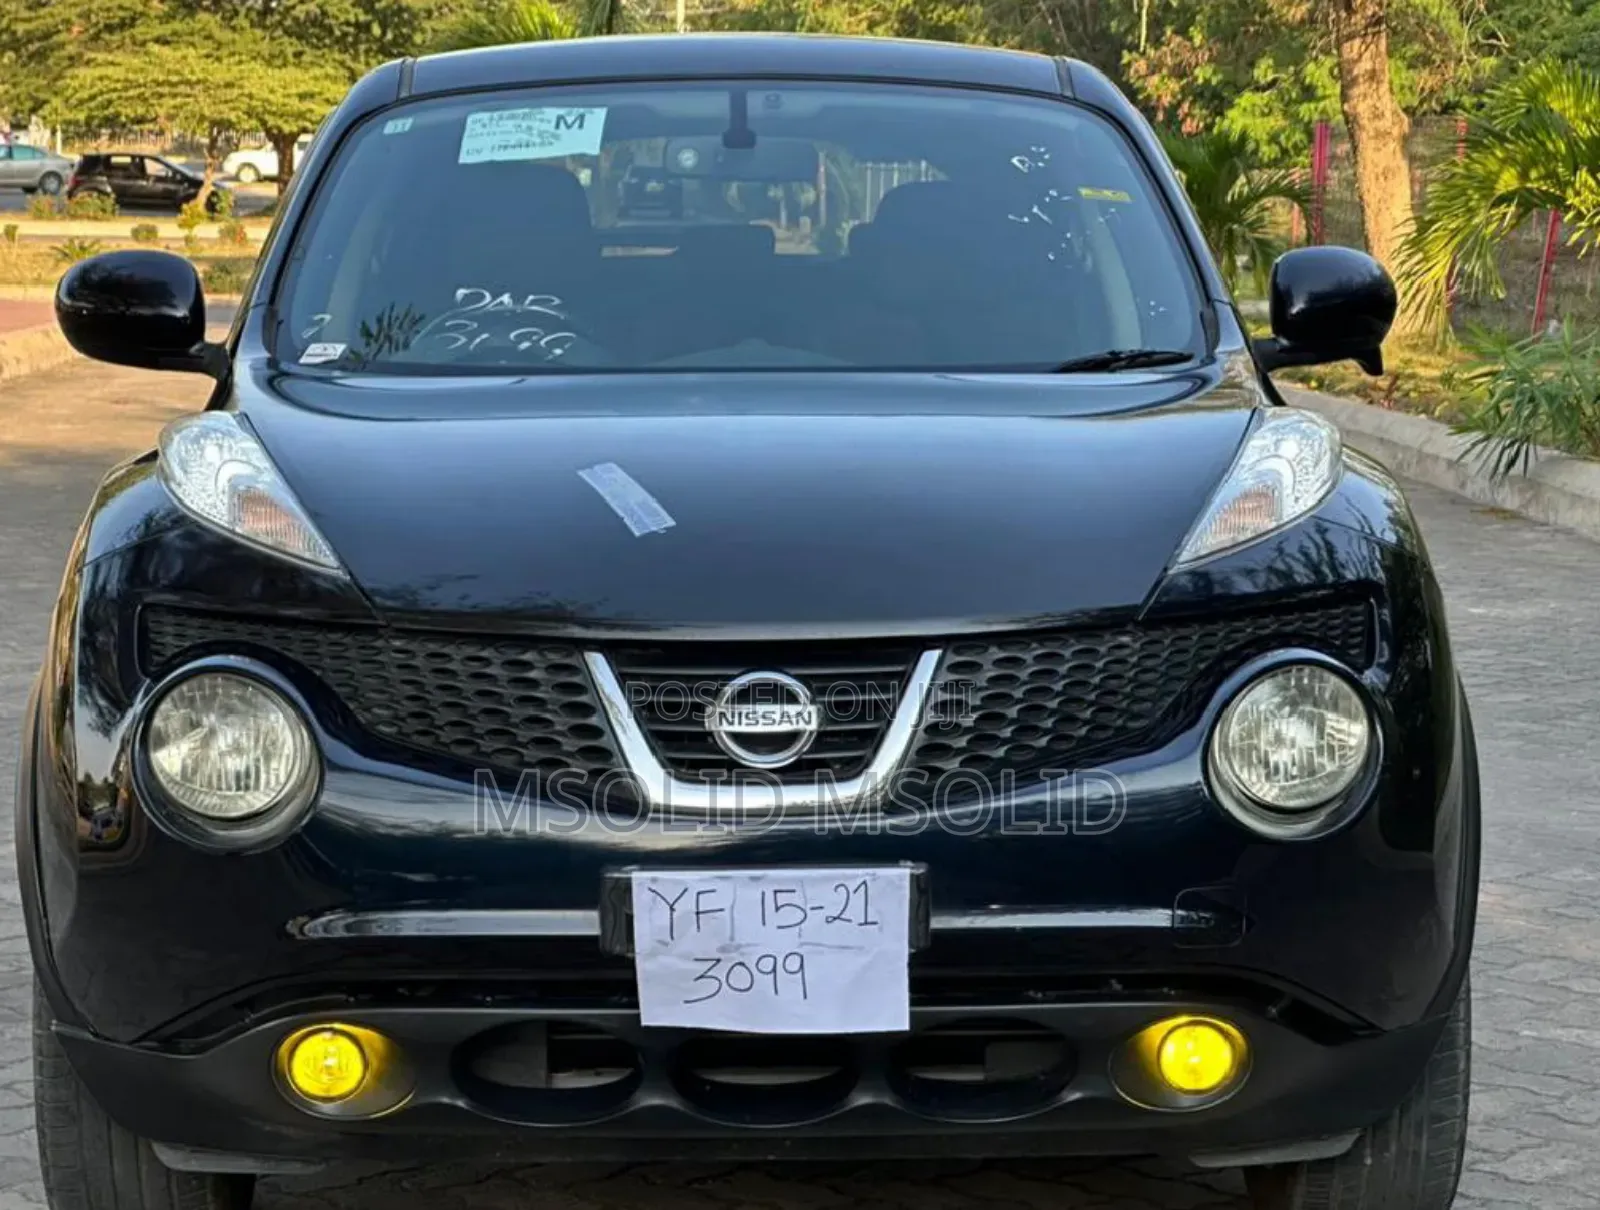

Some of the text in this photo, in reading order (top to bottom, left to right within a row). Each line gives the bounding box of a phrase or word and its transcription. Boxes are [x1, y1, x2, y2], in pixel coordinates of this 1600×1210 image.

[554, 113, 586, 131] M
[716, 708, 815, 728] NISSAN
[648, 879, 879, 941] YF 15-21
[683, 951, 808, 1004] 3099
